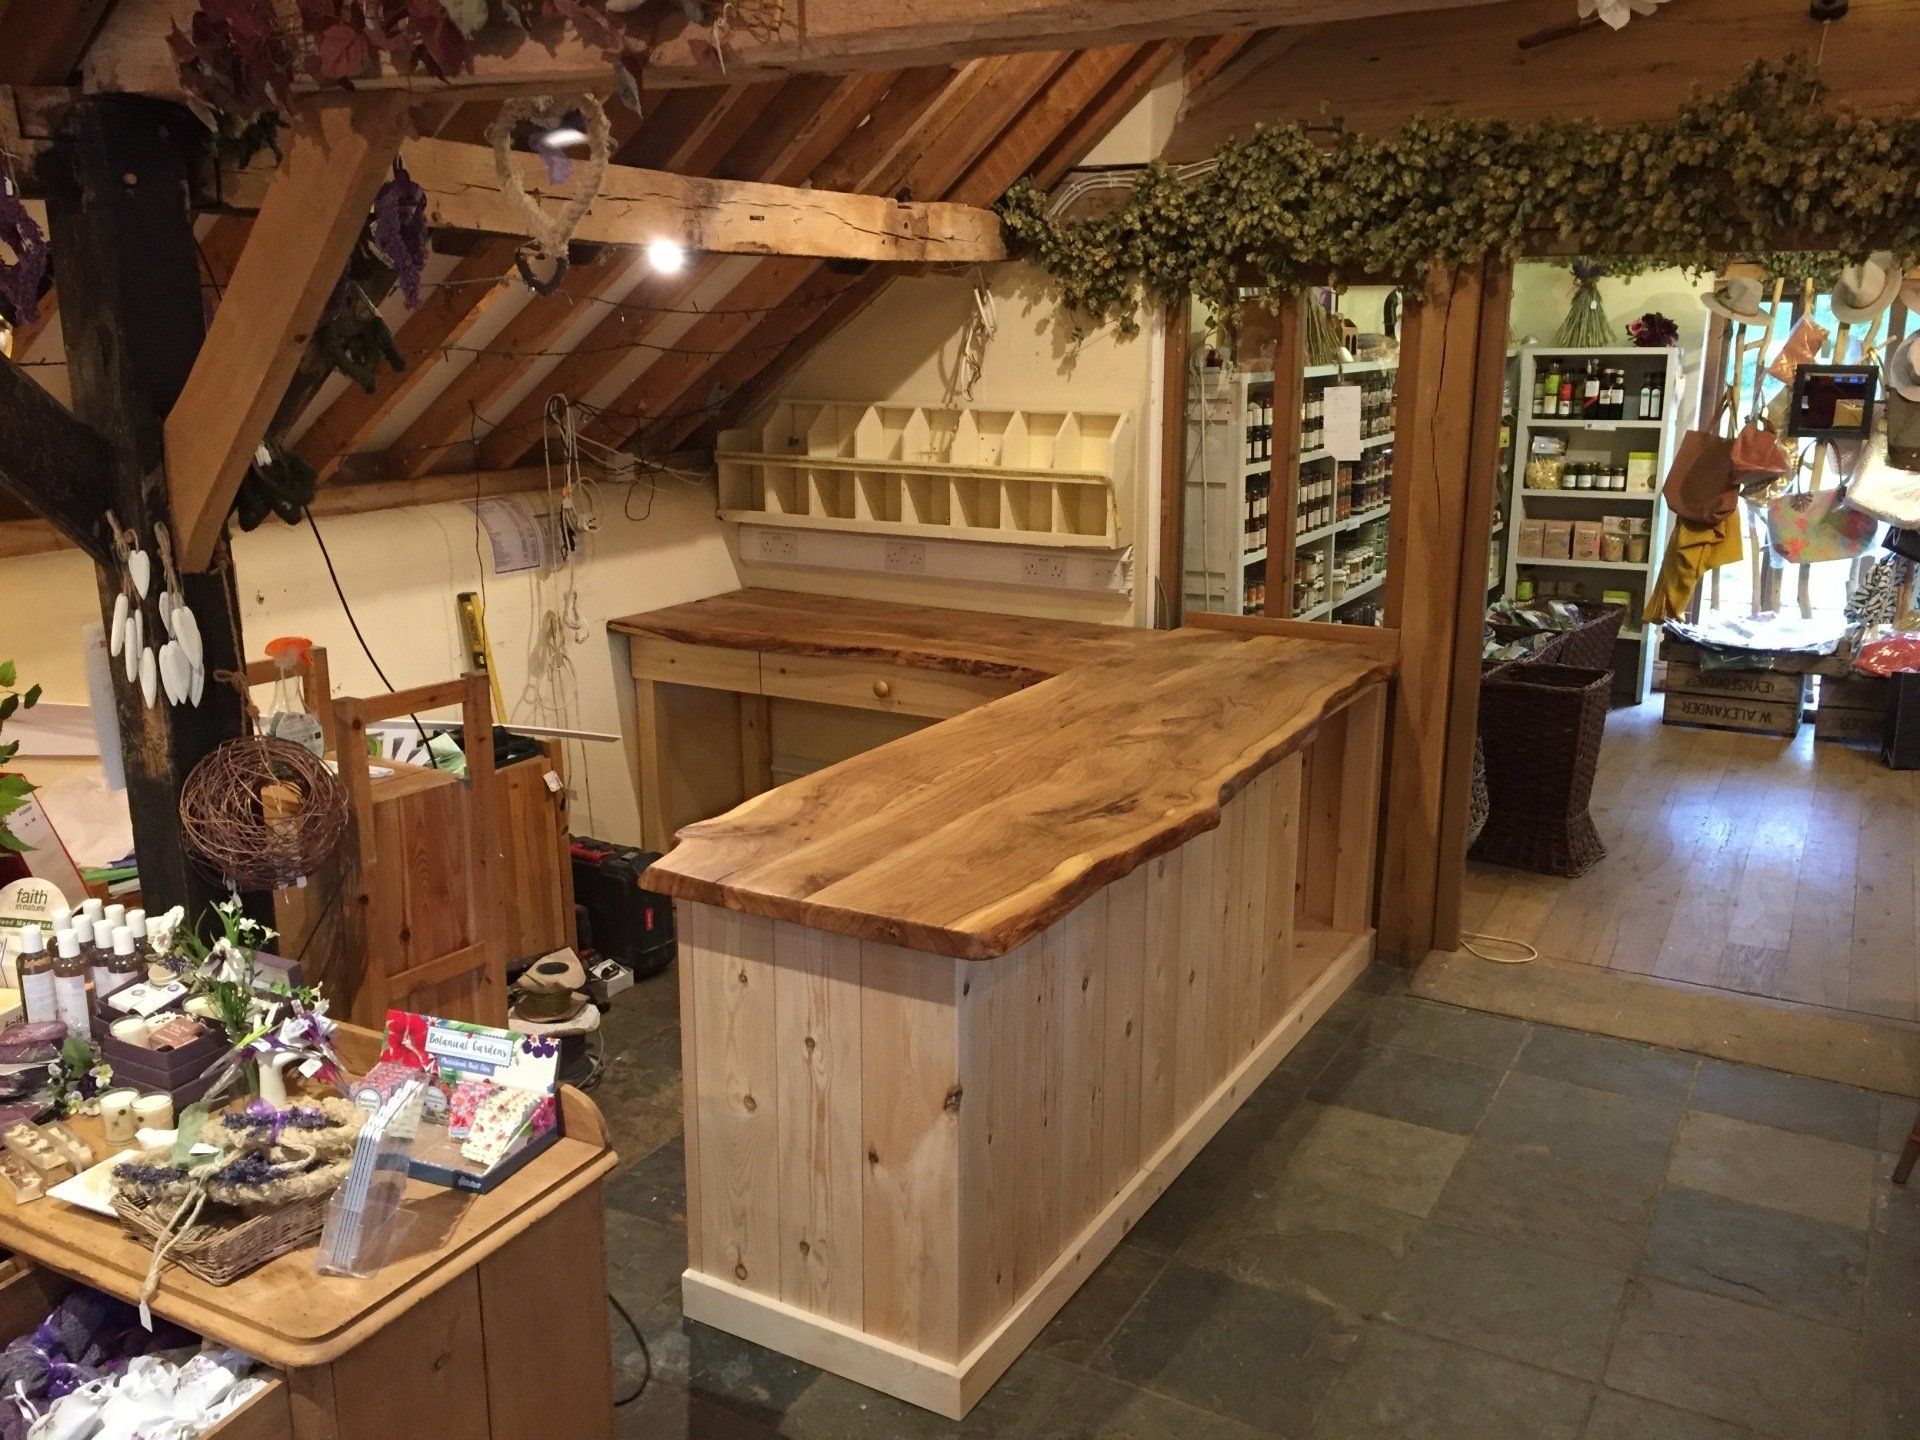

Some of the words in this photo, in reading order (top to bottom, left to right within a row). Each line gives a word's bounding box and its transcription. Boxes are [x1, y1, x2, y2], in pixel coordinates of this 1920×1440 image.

[16, 888, 48, 905] faith
[22, 904, 46, 912] nature
[429, 1033, 468, 1051] Botanical
[472, 1041, 507, 1057] Gardens
